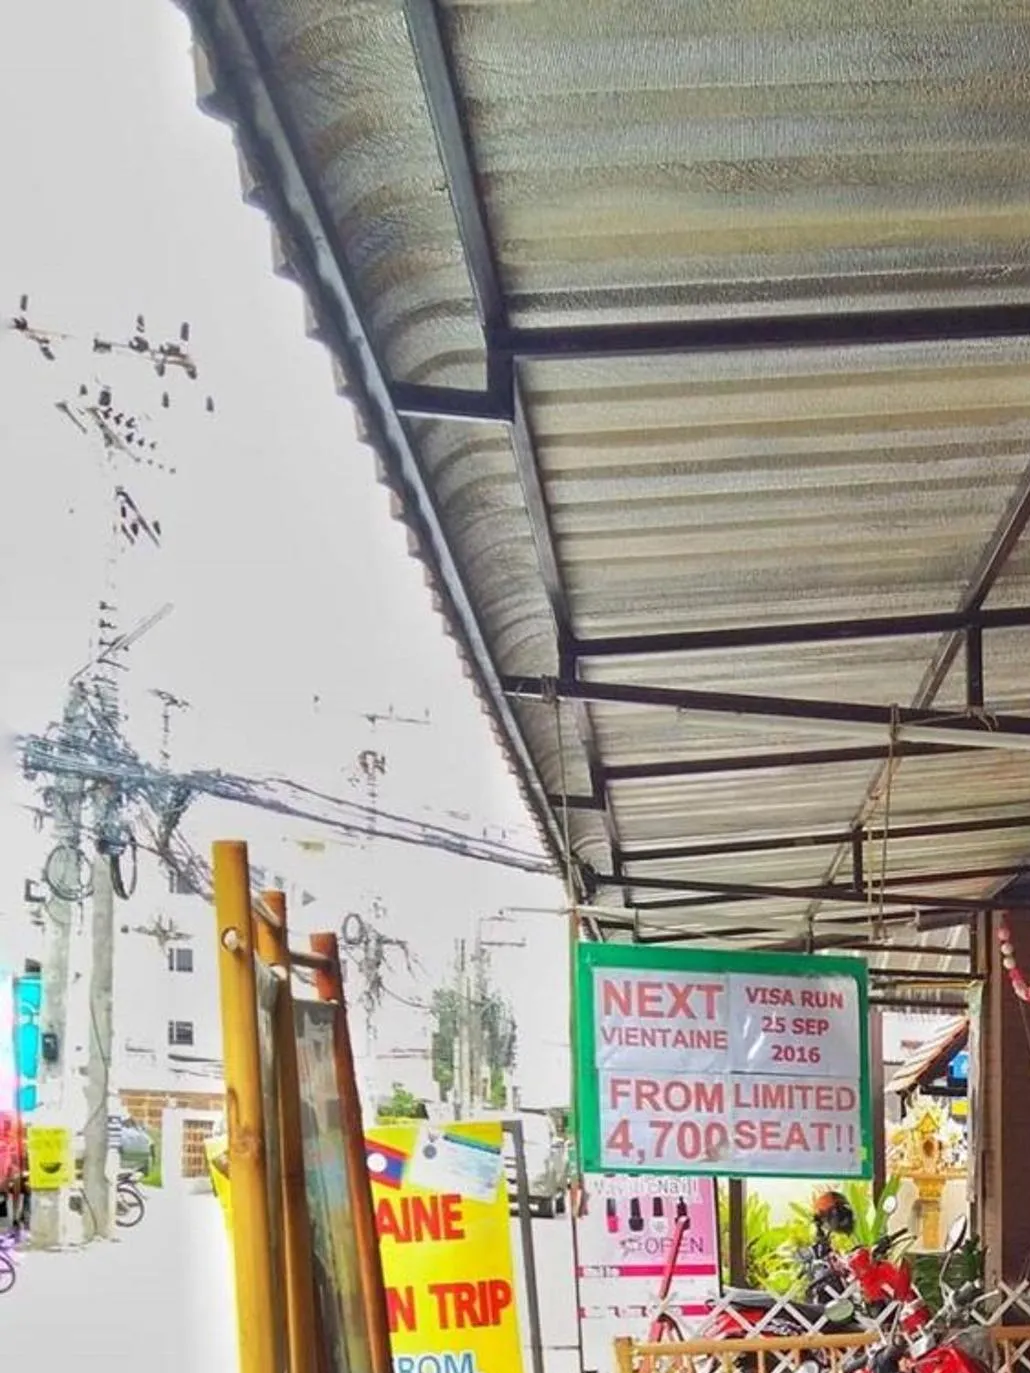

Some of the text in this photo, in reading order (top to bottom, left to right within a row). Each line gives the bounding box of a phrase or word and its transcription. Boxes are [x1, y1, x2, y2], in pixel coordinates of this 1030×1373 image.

[603, 980, 724, 1020] NEXT
[745, 985, 844, 1010] VISA RUN
[600, 1026, 729, 1050] VIENTAINE
[761, 1016, 829, 1036] 25 SEP
[771, 1044, 821, 1063] 2016
[610, 1078, 724, 1113] FROM
[734, 1083, 856, 1111] LIMITED
[606, 1119, 730, 1164] 4,700
[733, 1119, 855, 1153] SEAT!!
[376, 1194, 465, 1243] AINE
[387, 1280, 512, 1333] N TRIP
